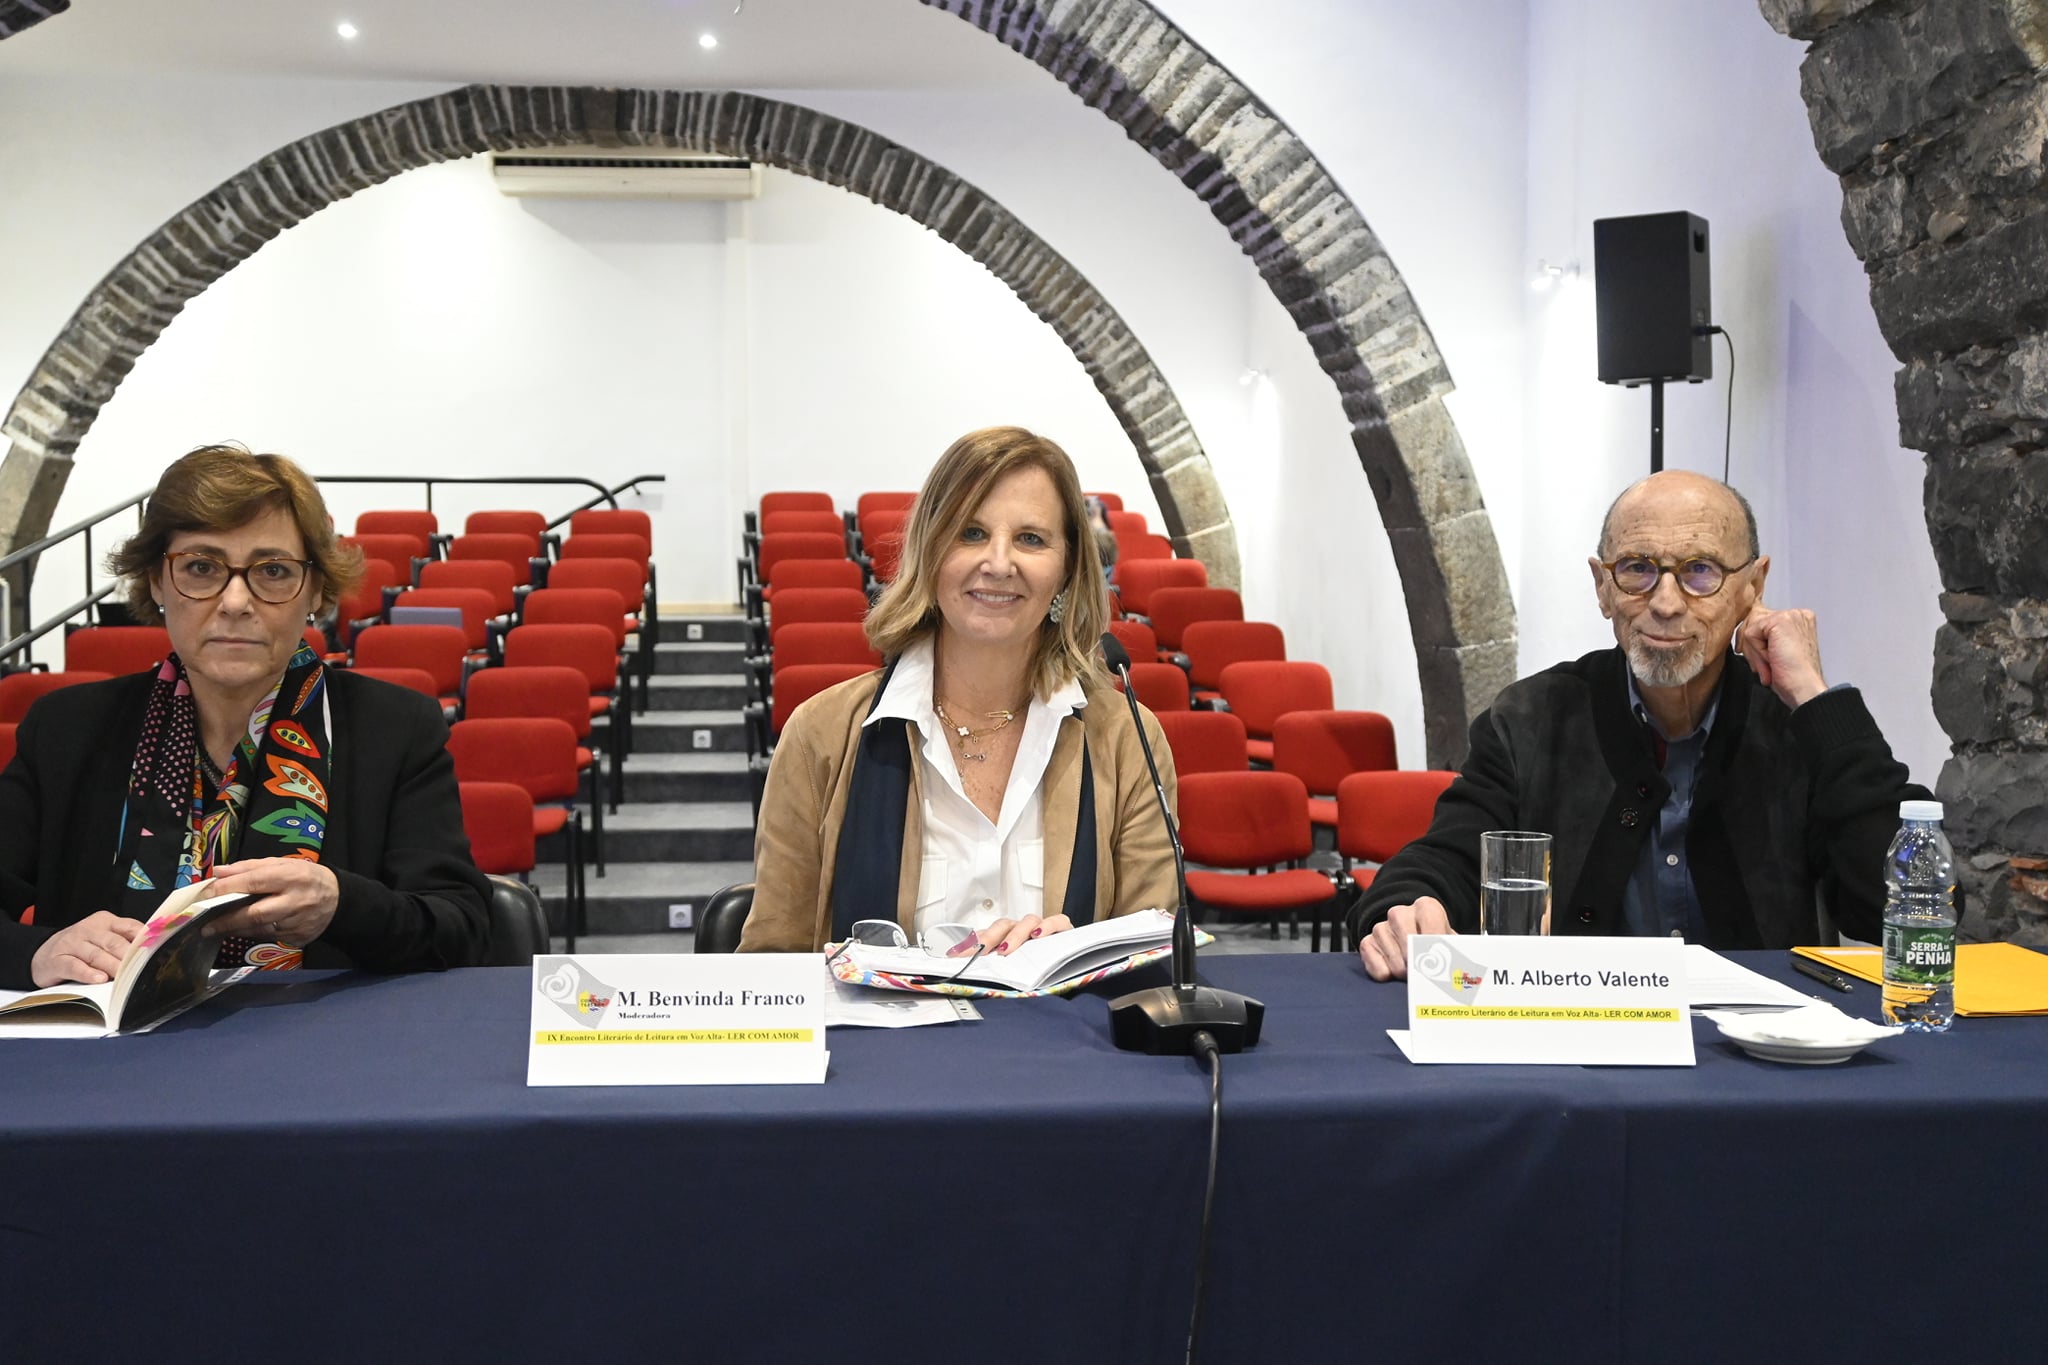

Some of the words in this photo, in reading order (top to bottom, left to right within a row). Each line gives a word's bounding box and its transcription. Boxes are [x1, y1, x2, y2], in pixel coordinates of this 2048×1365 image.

[1910, 941, 1943, 951] SERRA
[1906, 950, 1952, 965] PENHA
[1492, 969, 1515, 986] M.
[1520, 969, 1592, 987] Alberto
[1598, 971, 1670, 988] Valente
[617, 991, 642, 1007] M.
[648, 990, 734, 1007] Benvinda
[741, 990, 806, 1006] Franco
[618, 1011, 672, 1020] Moderadora
[1420, 1008, 1430, 1016] IX
[1431, 1008, 1470, 1017] Encontro
[1471, 1008, 1506, 1017] Literário
[1508, 1009, 1519, 1017] de
[1520, 1009, 1550, 1017] Leitura
[1566, 1010, 1581, 1018] Voz
[1604, 1010, 1622, 1018] LER
[1623, 1010, 1644, 1018] COM
[1645, 1010, 1672, 1019] AMOR
[547, 1034, 558, 1042] IX
[560, 1033, 596, 1042] Encontro
[634, 1033, 643, 1041] de
[645, 1033, 675, 1041] Leitura
[690, 1033, 704, 1041] Voz
[727, 1032, 746, 1040] LER
[747, 1032, 770, 1040] COM
[771, 1031, 800, 1040] AMOR
